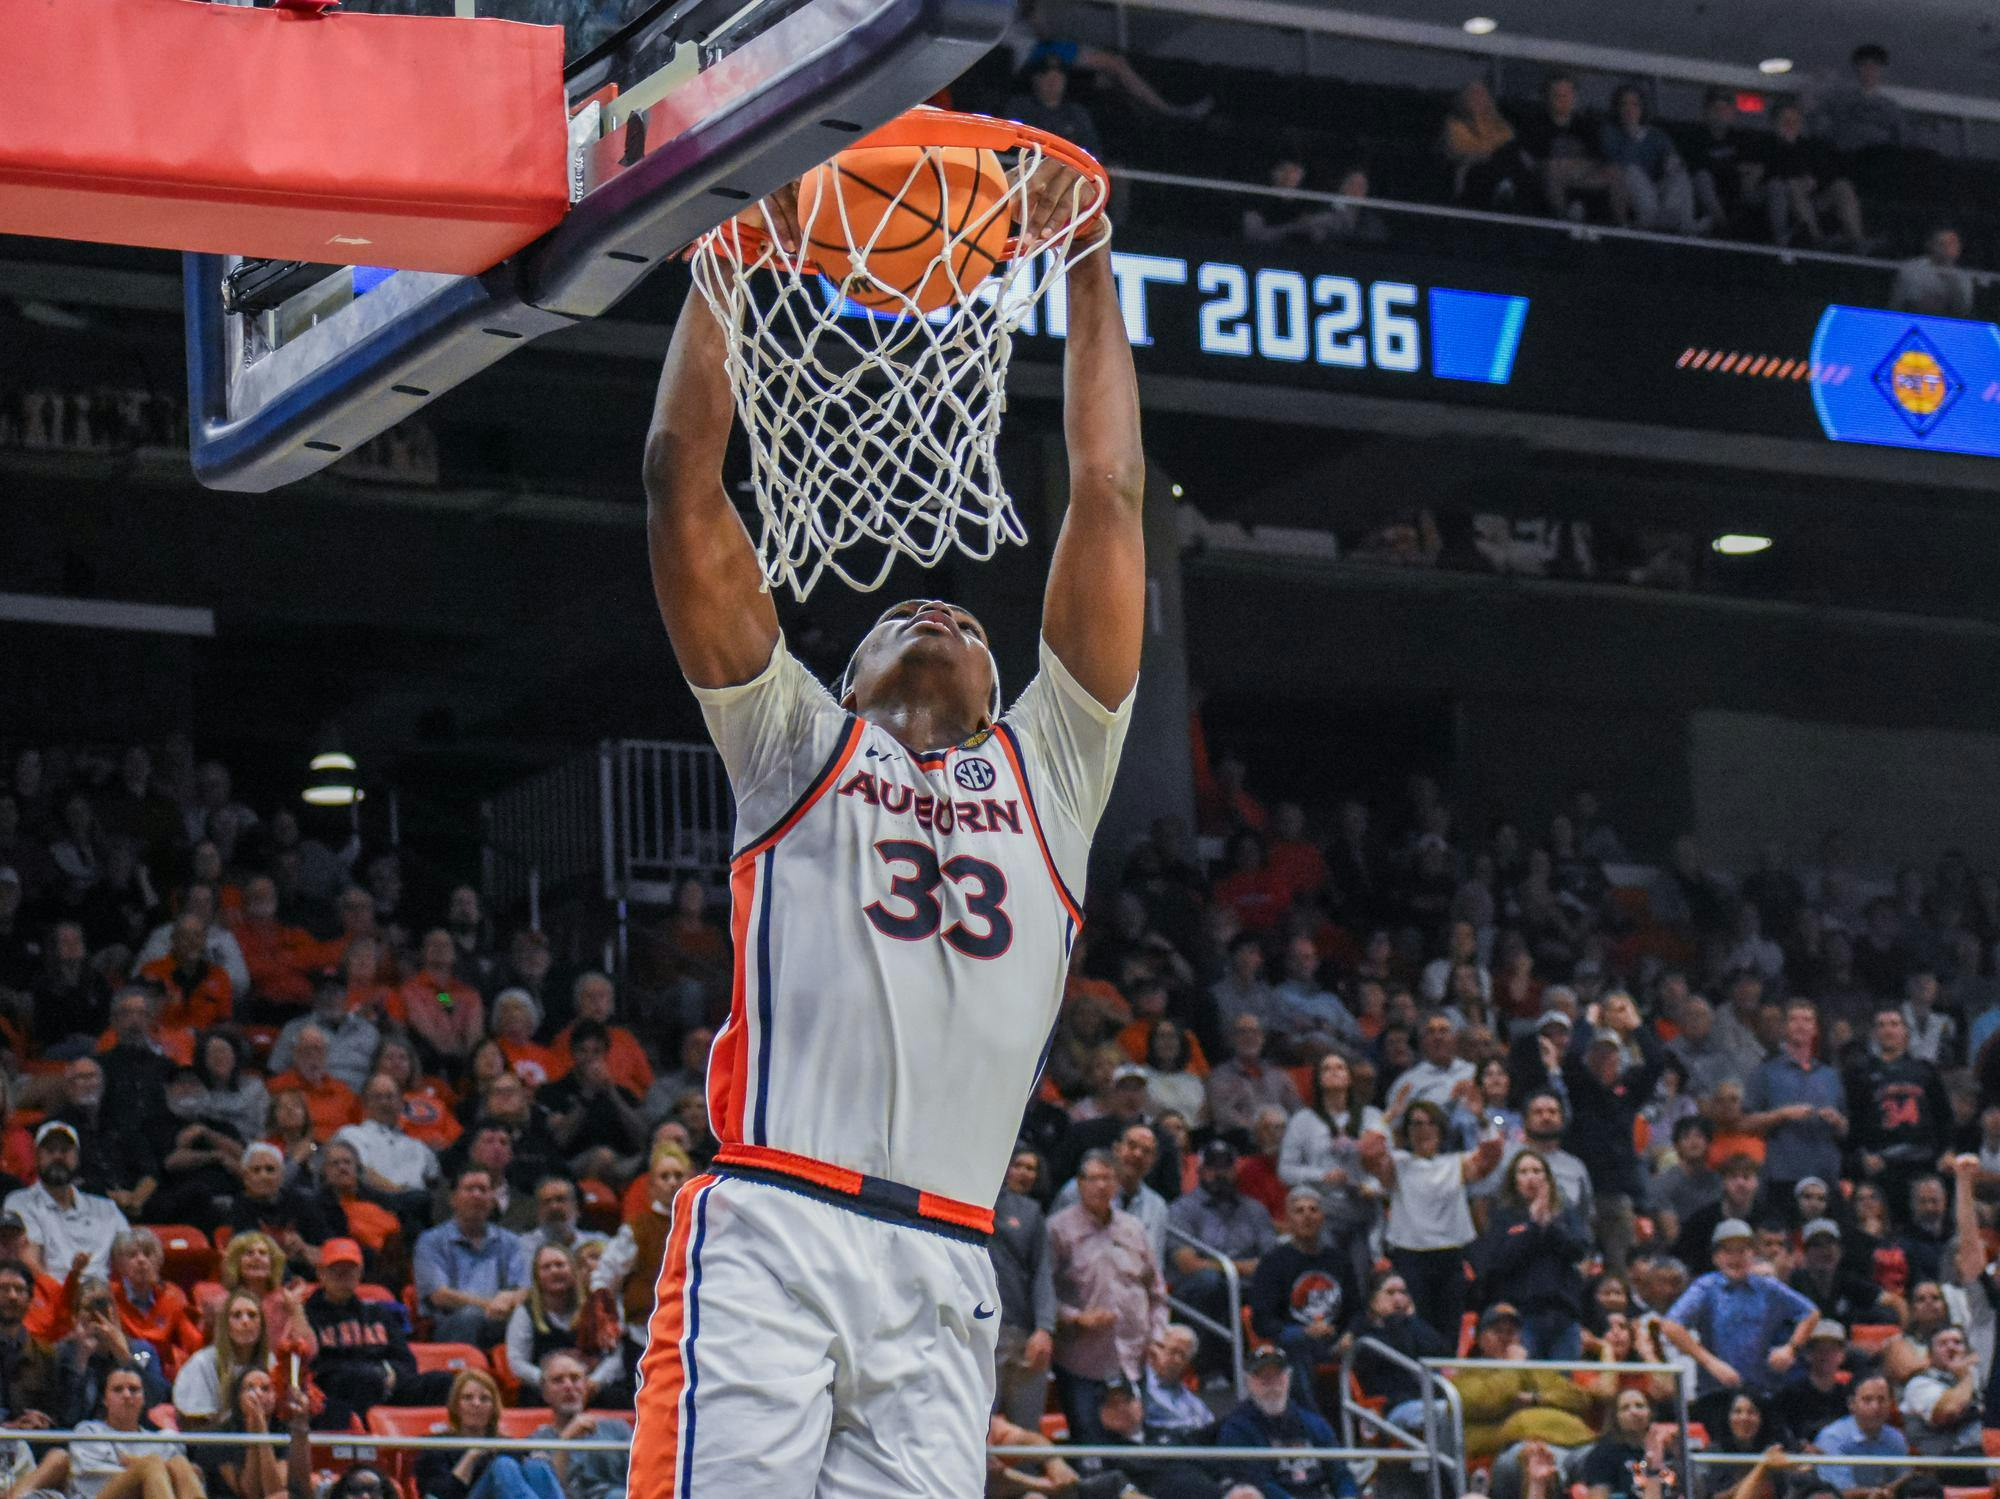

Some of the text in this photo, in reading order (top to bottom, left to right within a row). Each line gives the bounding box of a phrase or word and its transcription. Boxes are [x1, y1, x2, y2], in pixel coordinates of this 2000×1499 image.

[1198, 261, 1421, 373] 2026
[838, 770, 1023, 836] AUBURN
[955, 759, 994, 789] SEC
[863, 839, 1014, 960] 33
